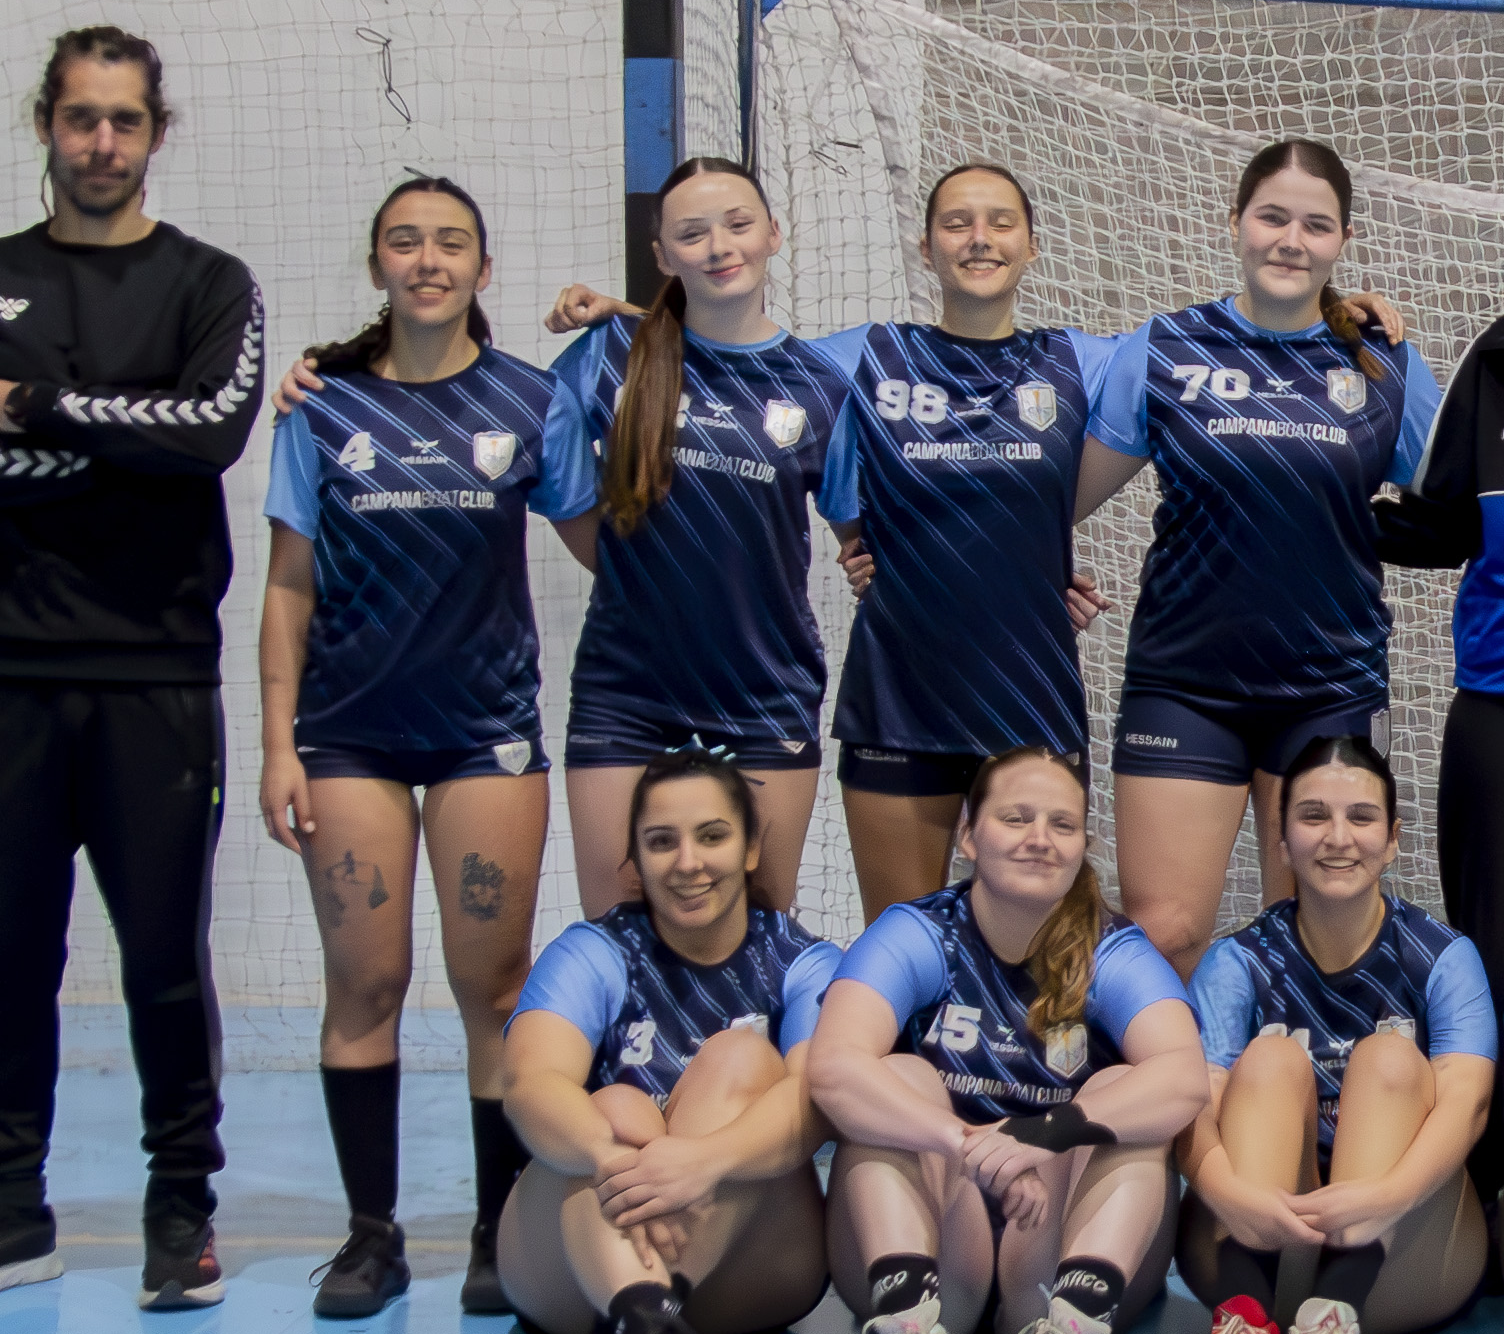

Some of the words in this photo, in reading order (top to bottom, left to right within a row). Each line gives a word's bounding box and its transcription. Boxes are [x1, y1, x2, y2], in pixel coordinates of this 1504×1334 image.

[875, 378, 950, 425] 98
[1171, 363, 1252, 402] 70
[1207, 416, 1347, 445] CAMPANABOATCLUB
[337, 431, 377, 473] 4
[903, 441, 1043, 461] CAMPANABOATCLUB
[619, 1019, 657, 1066] 3
